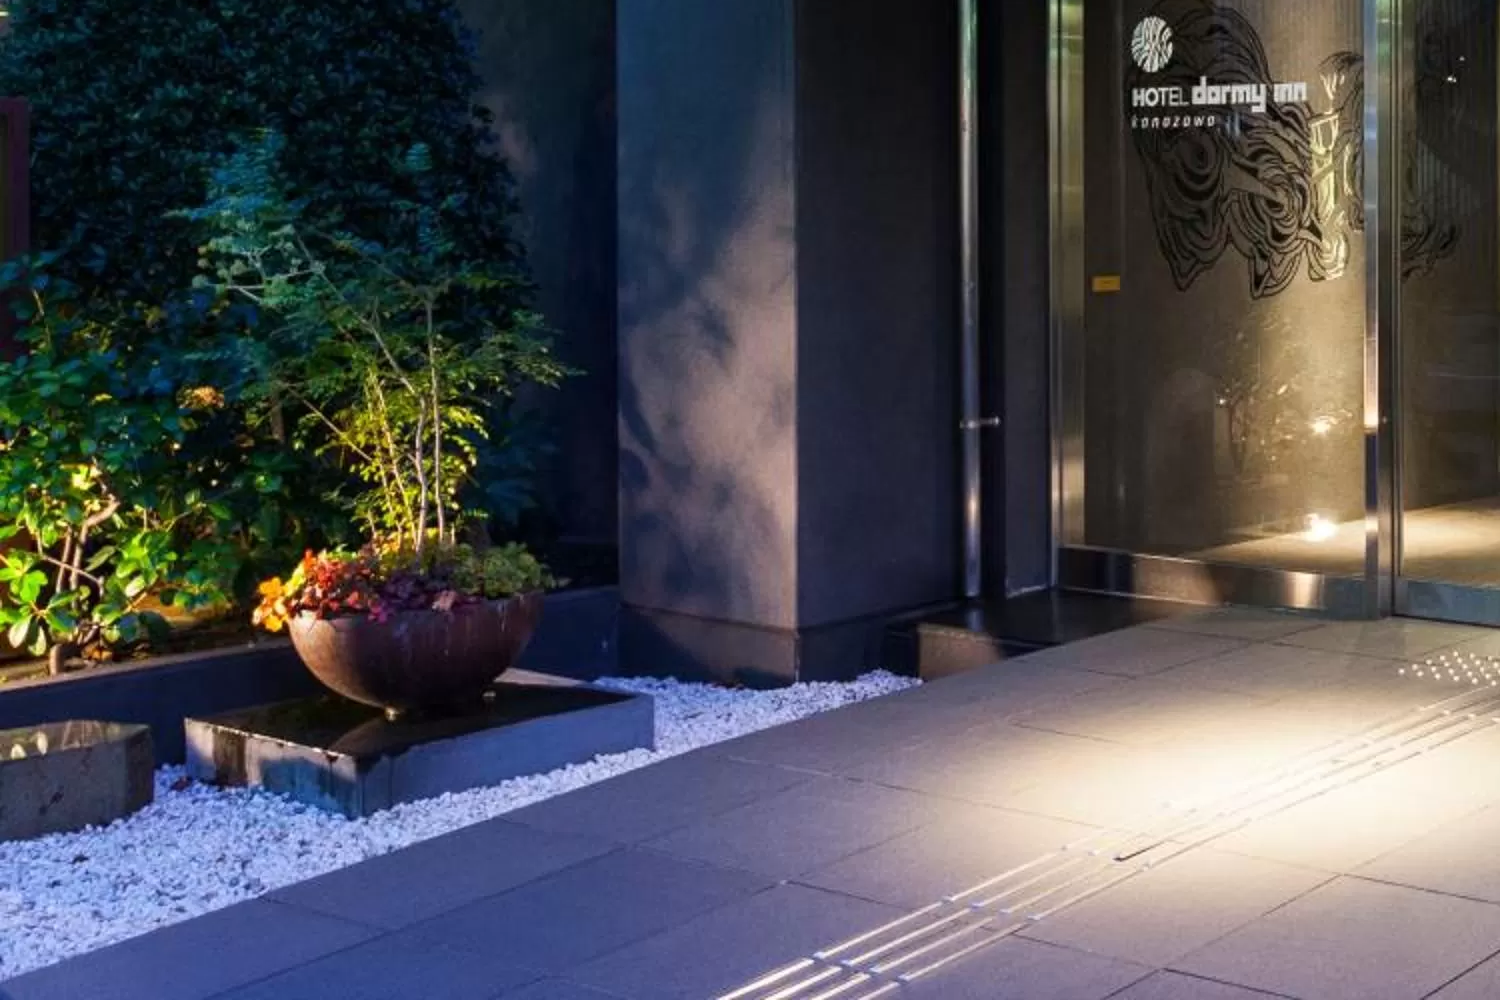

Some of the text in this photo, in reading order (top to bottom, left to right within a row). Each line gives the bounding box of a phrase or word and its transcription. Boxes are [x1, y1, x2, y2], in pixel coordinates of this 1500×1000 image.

[1132, 76, 1307, 112] HOTEL dormy inn
